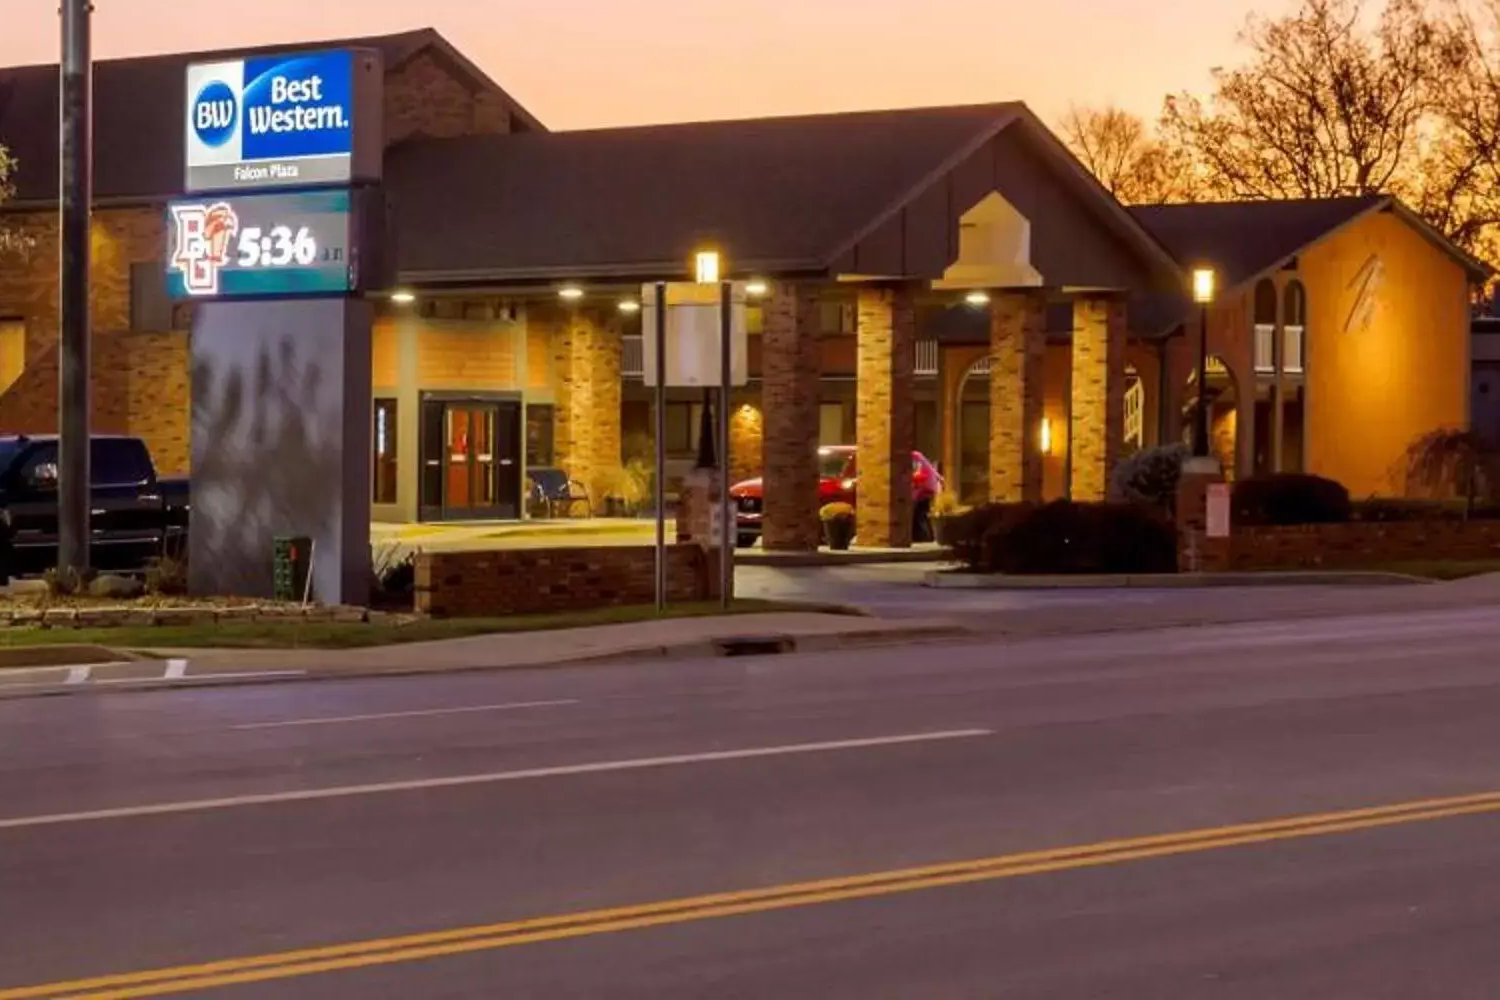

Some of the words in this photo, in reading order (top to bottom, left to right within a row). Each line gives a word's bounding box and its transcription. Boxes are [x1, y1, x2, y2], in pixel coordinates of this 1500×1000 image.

[271, 75, 323, 104] Best
[197, 99, 233, 129] BW
[234, 165, 268, 181] Falcon
[269, 163, 299, 178] Plaza
[237, 226, 317, 267] 5:36
